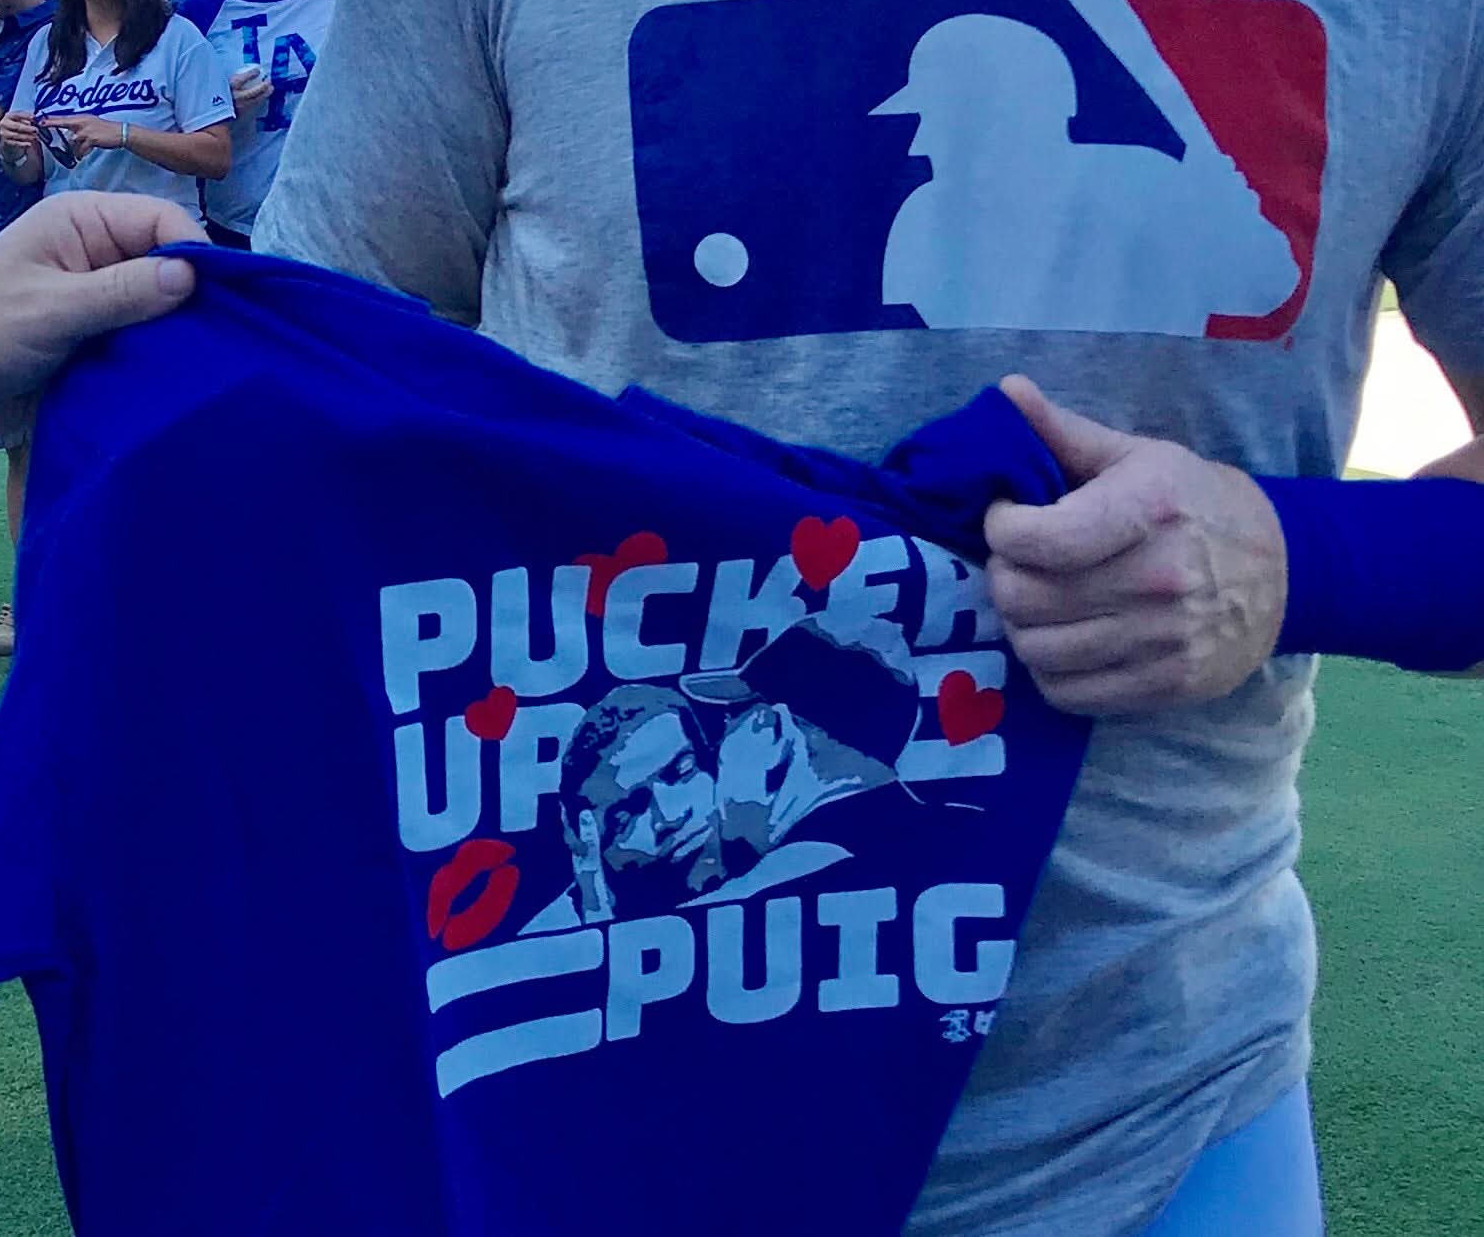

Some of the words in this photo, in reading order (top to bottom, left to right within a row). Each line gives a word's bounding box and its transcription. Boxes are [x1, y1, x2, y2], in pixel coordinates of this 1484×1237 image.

[34, 74, 159, 115] Dodgers
[379, 534, 1005, 715] PUCKER
[393, 702, 587, 853] UP
[605, 883, 1017, 1042] PUIG
